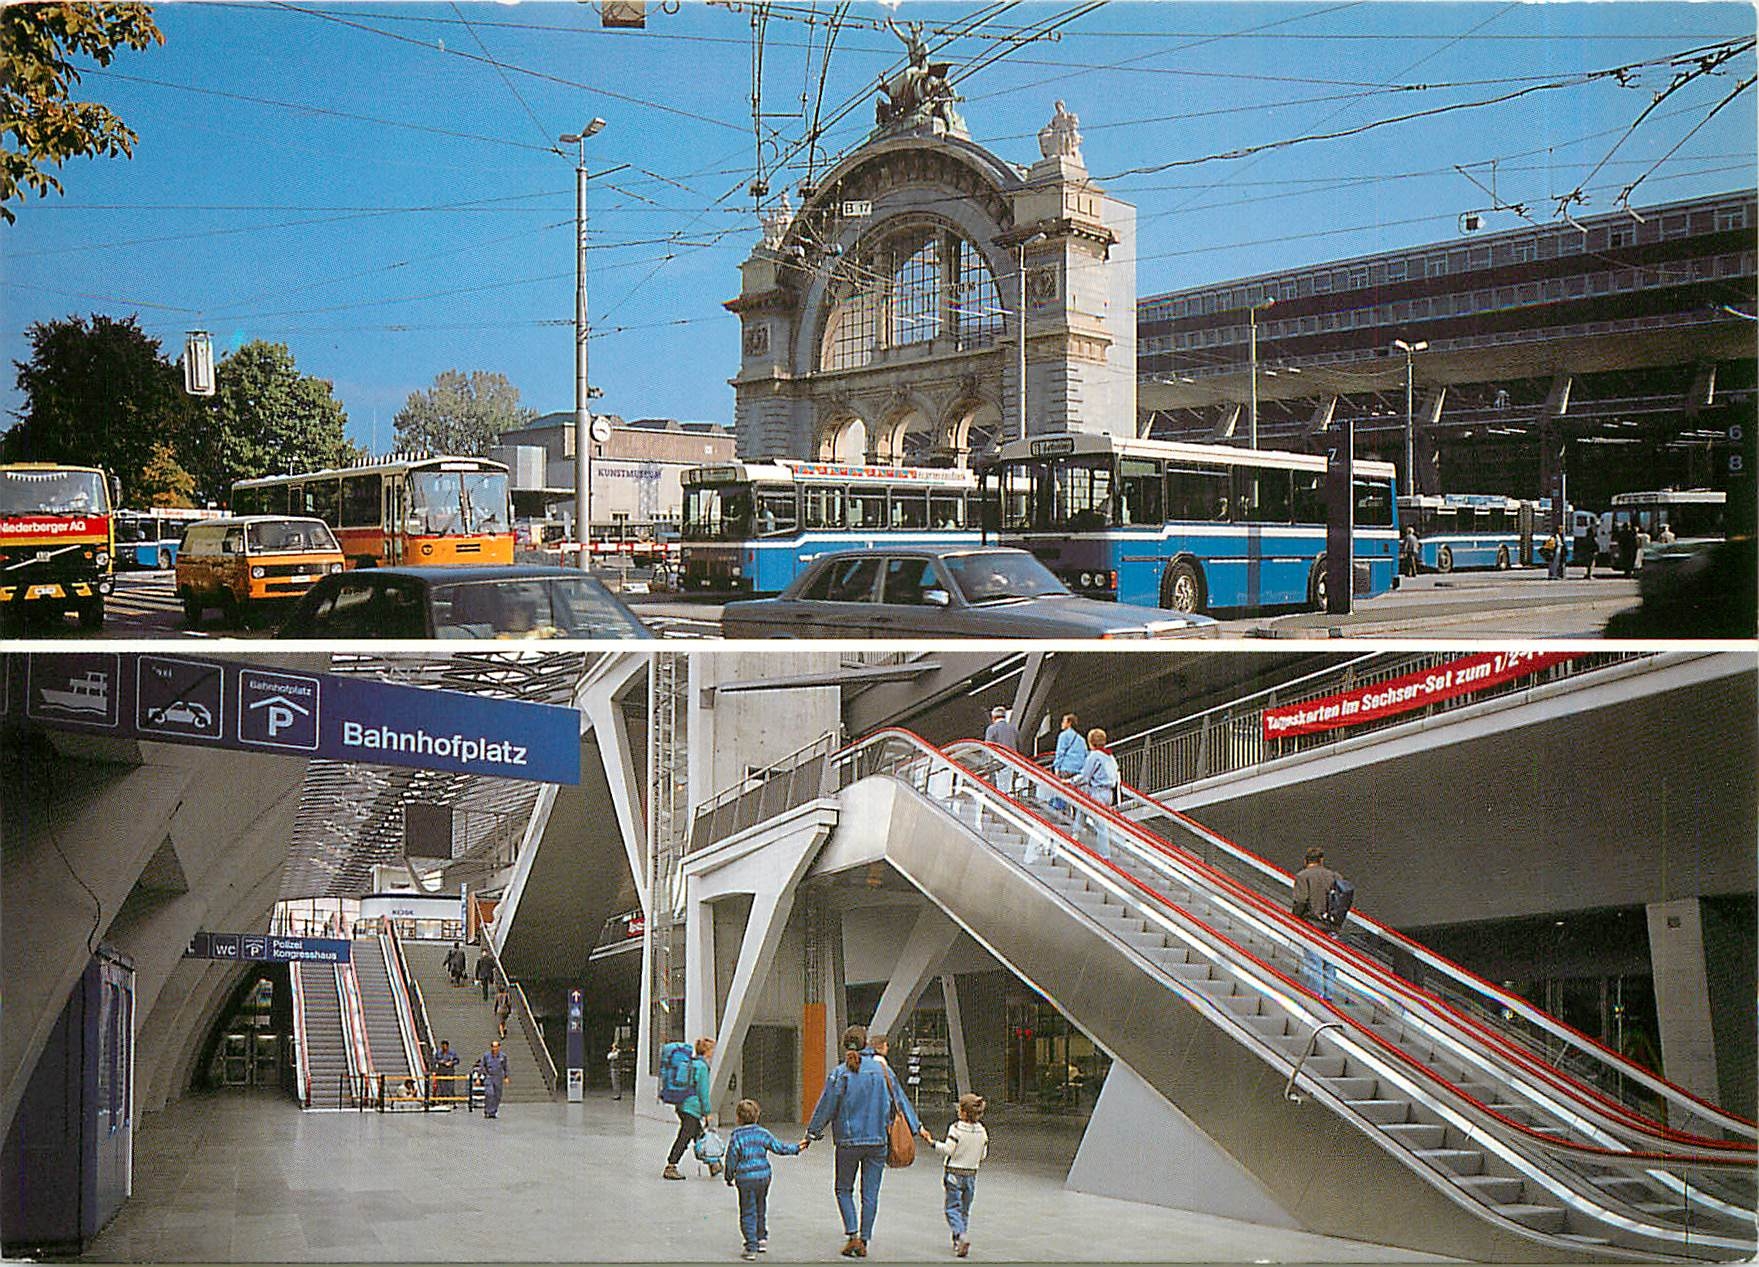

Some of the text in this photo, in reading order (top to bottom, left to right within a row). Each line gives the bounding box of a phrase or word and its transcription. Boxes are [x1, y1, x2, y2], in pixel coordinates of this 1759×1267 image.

[845, 203, 853, 213] B
[1728, 424, 1743, 440] 6
[1328, 447, 1338, 461] 7
[598, 468, 662, 479] KUNSTMUSEUM
[69, 520, 86, 532] AG
[249, 679, 313, 697] Bahnhofplatz
[1266, 703, 1340, 731] Tageskarten
[1341, 699, 1361, 716] im
[1361, 670, 1453, 711] Sechser-Set
[1455, 662, 1492, 685] zum
[268, 705, 294, 737] P
[343, 720, 528, 766] Bahnhofplatz
[215, 944, 236, 956] WC
[272, 940, 303, 950] Polizei
[250, 946, 259, 957] P
[272, 949, 338, 961] Kongresshaus
